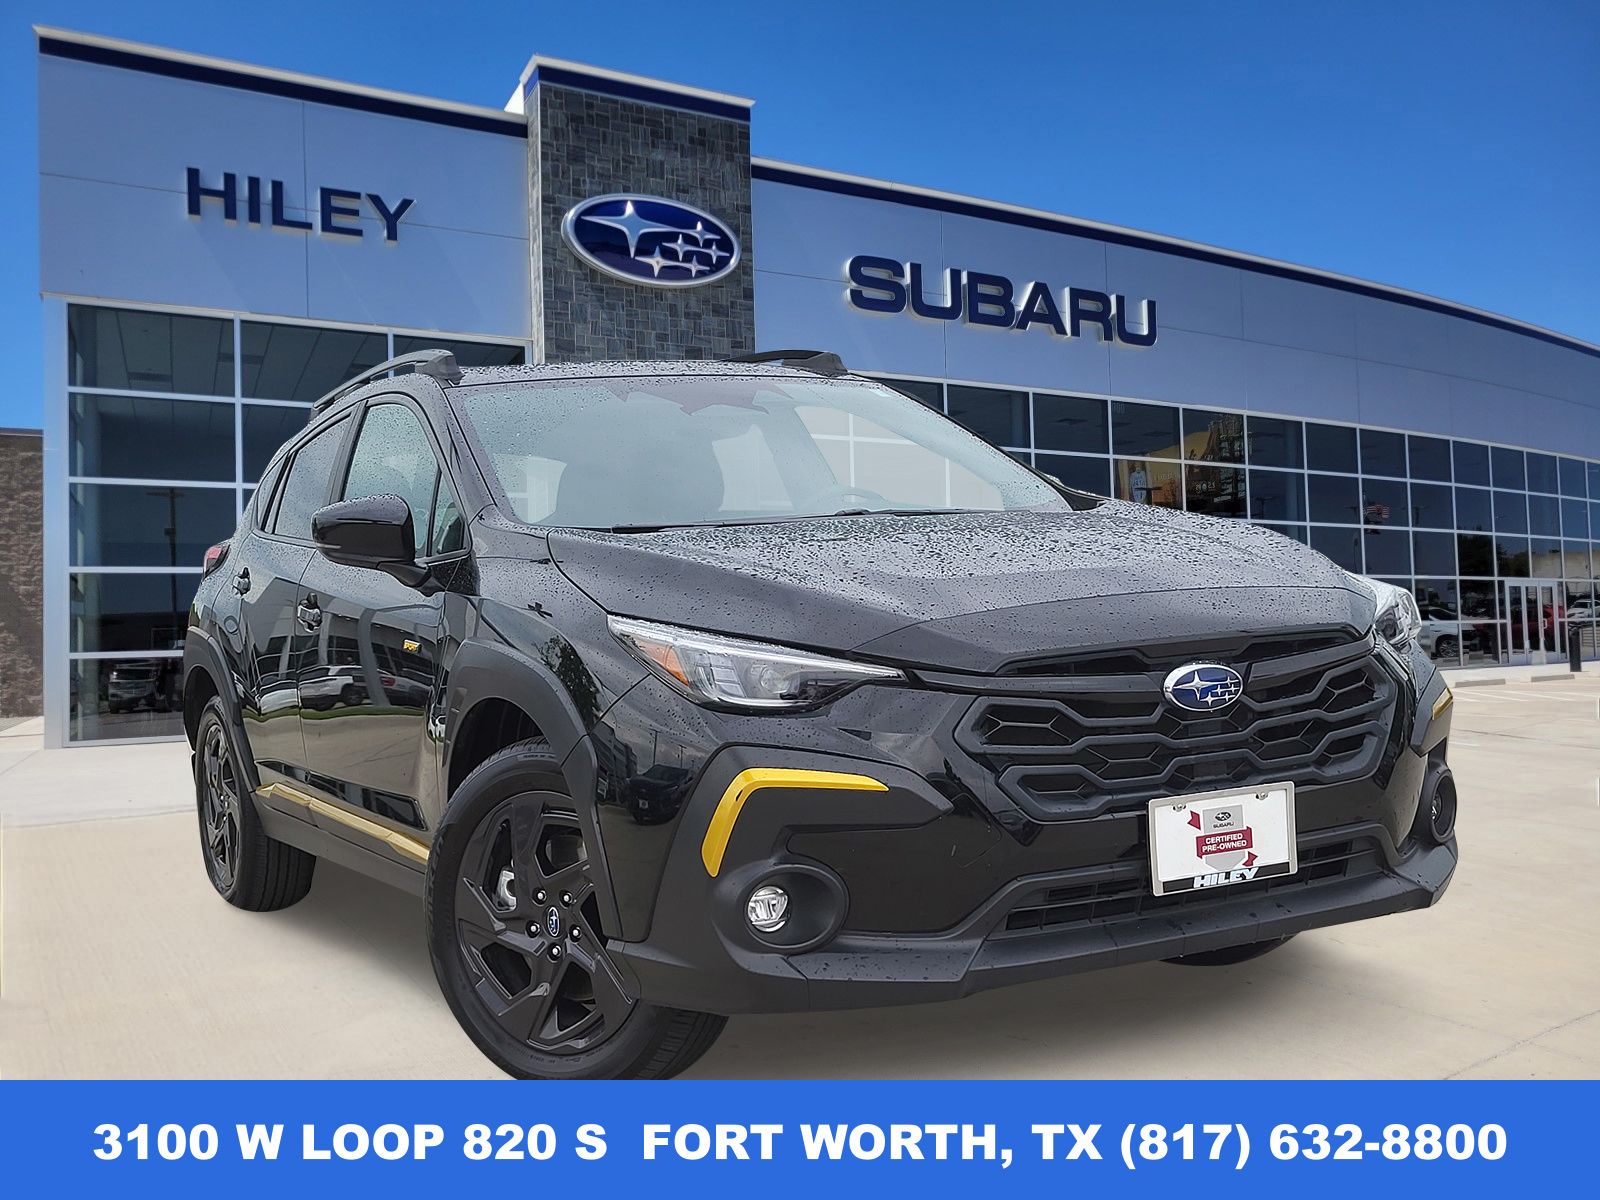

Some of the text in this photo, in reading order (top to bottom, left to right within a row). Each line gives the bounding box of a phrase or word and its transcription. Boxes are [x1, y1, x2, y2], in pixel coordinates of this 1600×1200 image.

[185, 166, 416, 243] HILEY
[845, 254, 1158, 347] SUBARU
[1202, 840, 1247, 852] PRE-OWNED
[1205, 833, 1243, 845] CERTIFIED
[1193, 867, 1259, 888] HILEY
